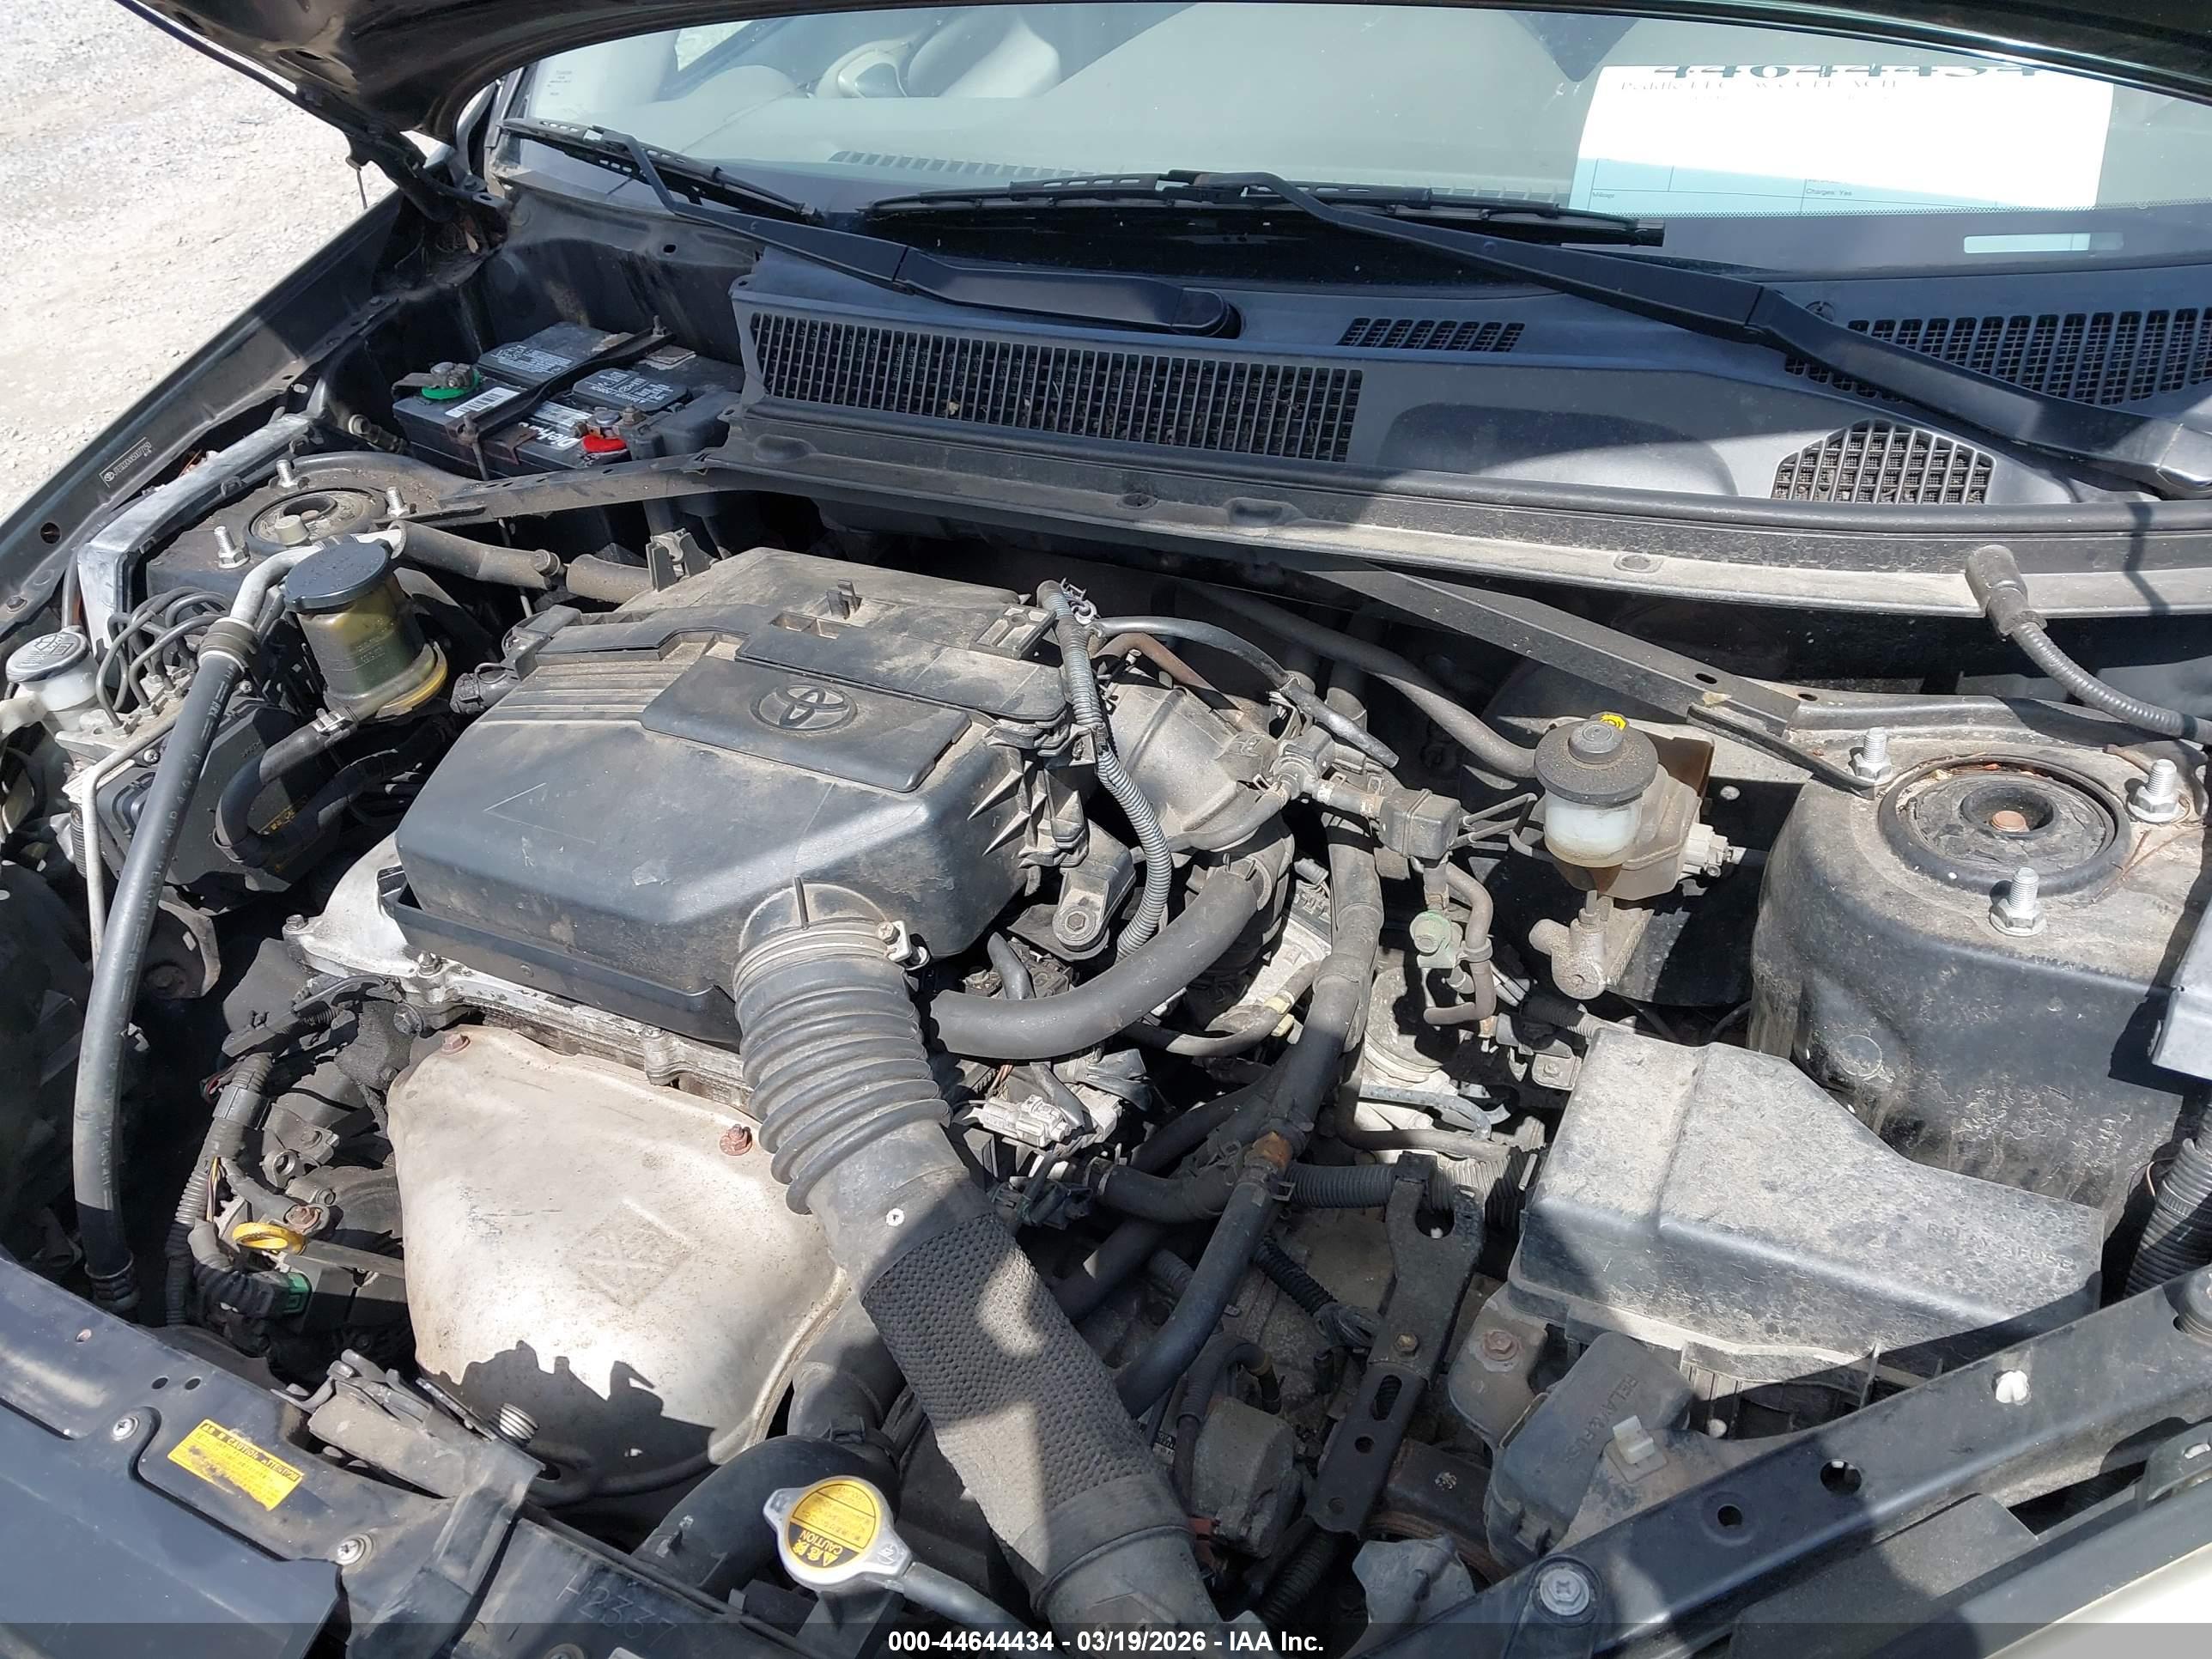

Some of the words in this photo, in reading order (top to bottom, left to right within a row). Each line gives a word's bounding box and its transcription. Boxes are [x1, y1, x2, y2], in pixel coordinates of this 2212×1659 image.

[227, 1437, 260, 1460] CAUTION
[799, 1529, 843, 1555] CAUTION
[556, 1573, 678, 1648] H2337
